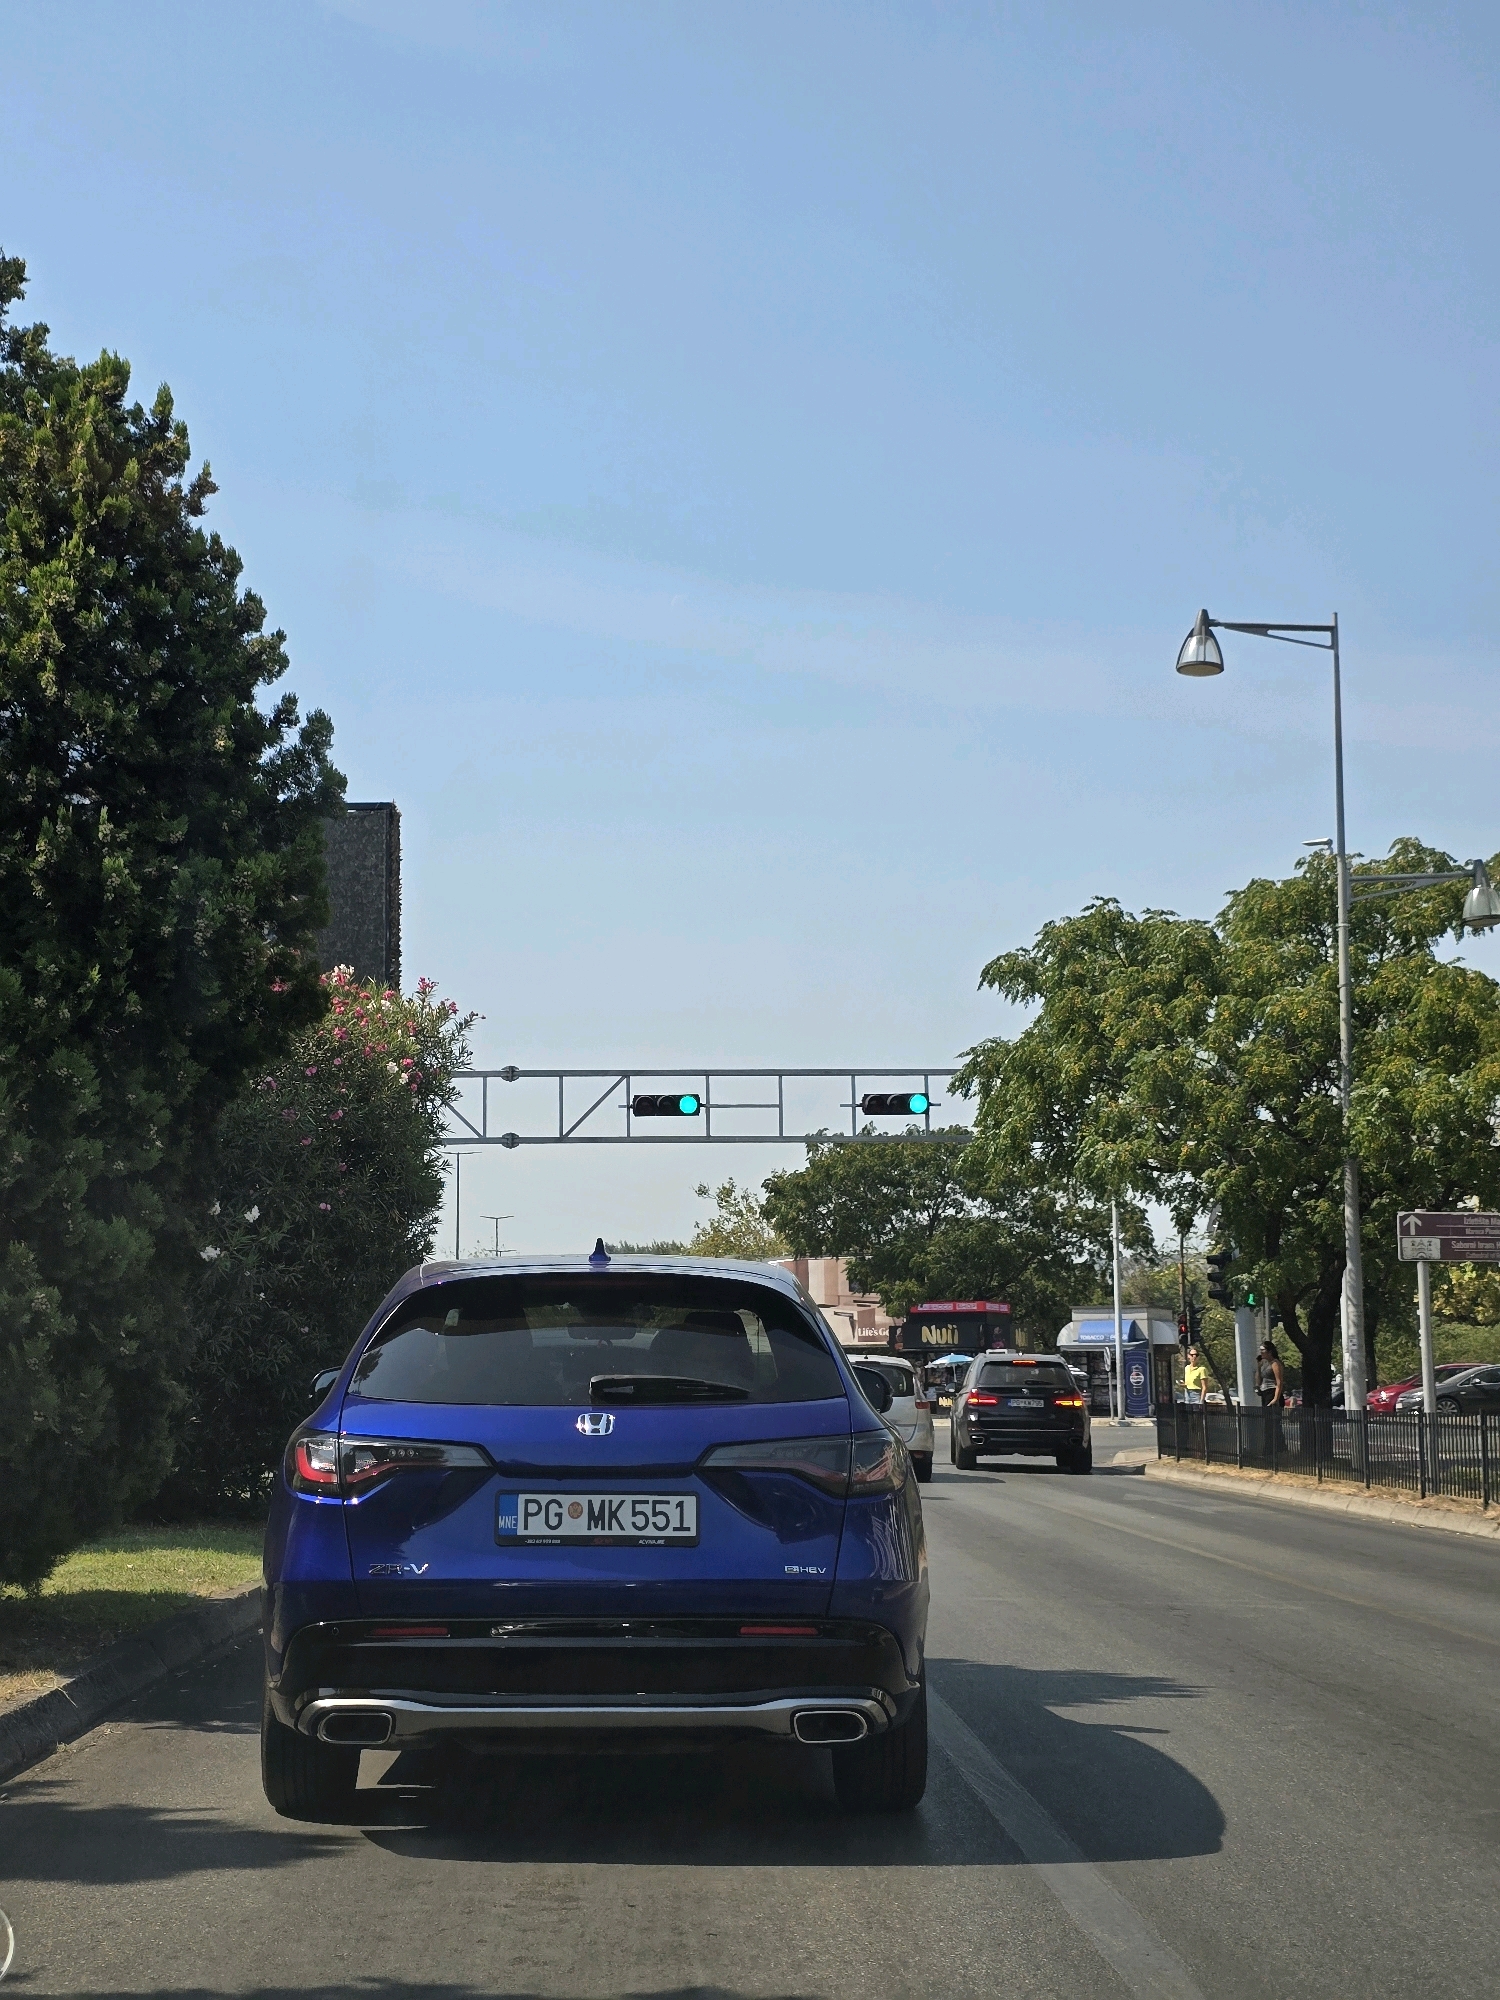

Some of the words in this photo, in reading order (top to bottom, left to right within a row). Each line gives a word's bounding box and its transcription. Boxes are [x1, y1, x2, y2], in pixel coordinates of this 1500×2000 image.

[858, 1327, 879, 1337] Life's
[879, 1327, 889, 1337] Go
[921, 1324, 959, 1345] Nuii
[523, 1498, 563, 1531] PG
[498, 1515, 518, 1529] MNE
[368, 1563, 429, 1575] ZR-V
